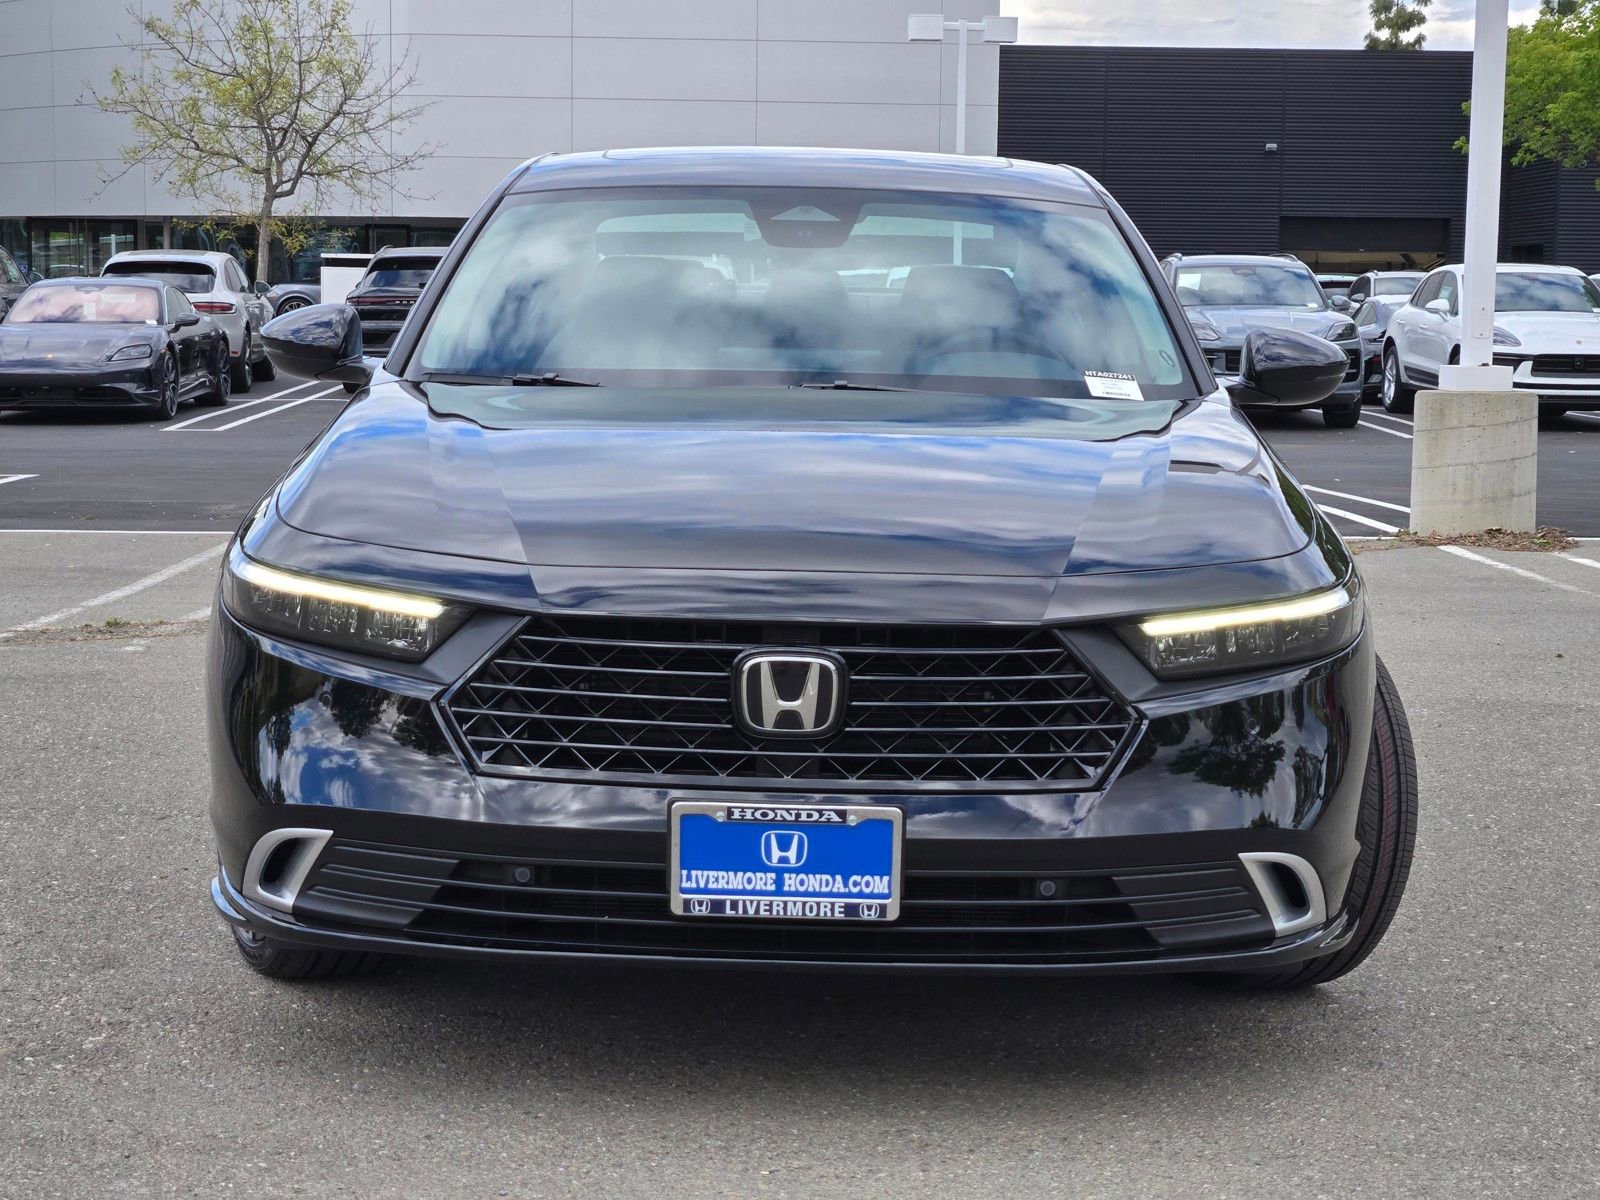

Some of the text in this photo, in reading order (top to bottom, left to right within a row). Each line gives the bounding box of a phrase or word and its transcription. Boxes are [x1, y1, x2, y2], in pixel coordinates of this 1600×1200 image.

[730, 808, 843, 822] HONDA
[681, 869, 890, 894] LIVERMORE HONDA.COM
[725, 899, 846, 918] LIVERMORE
